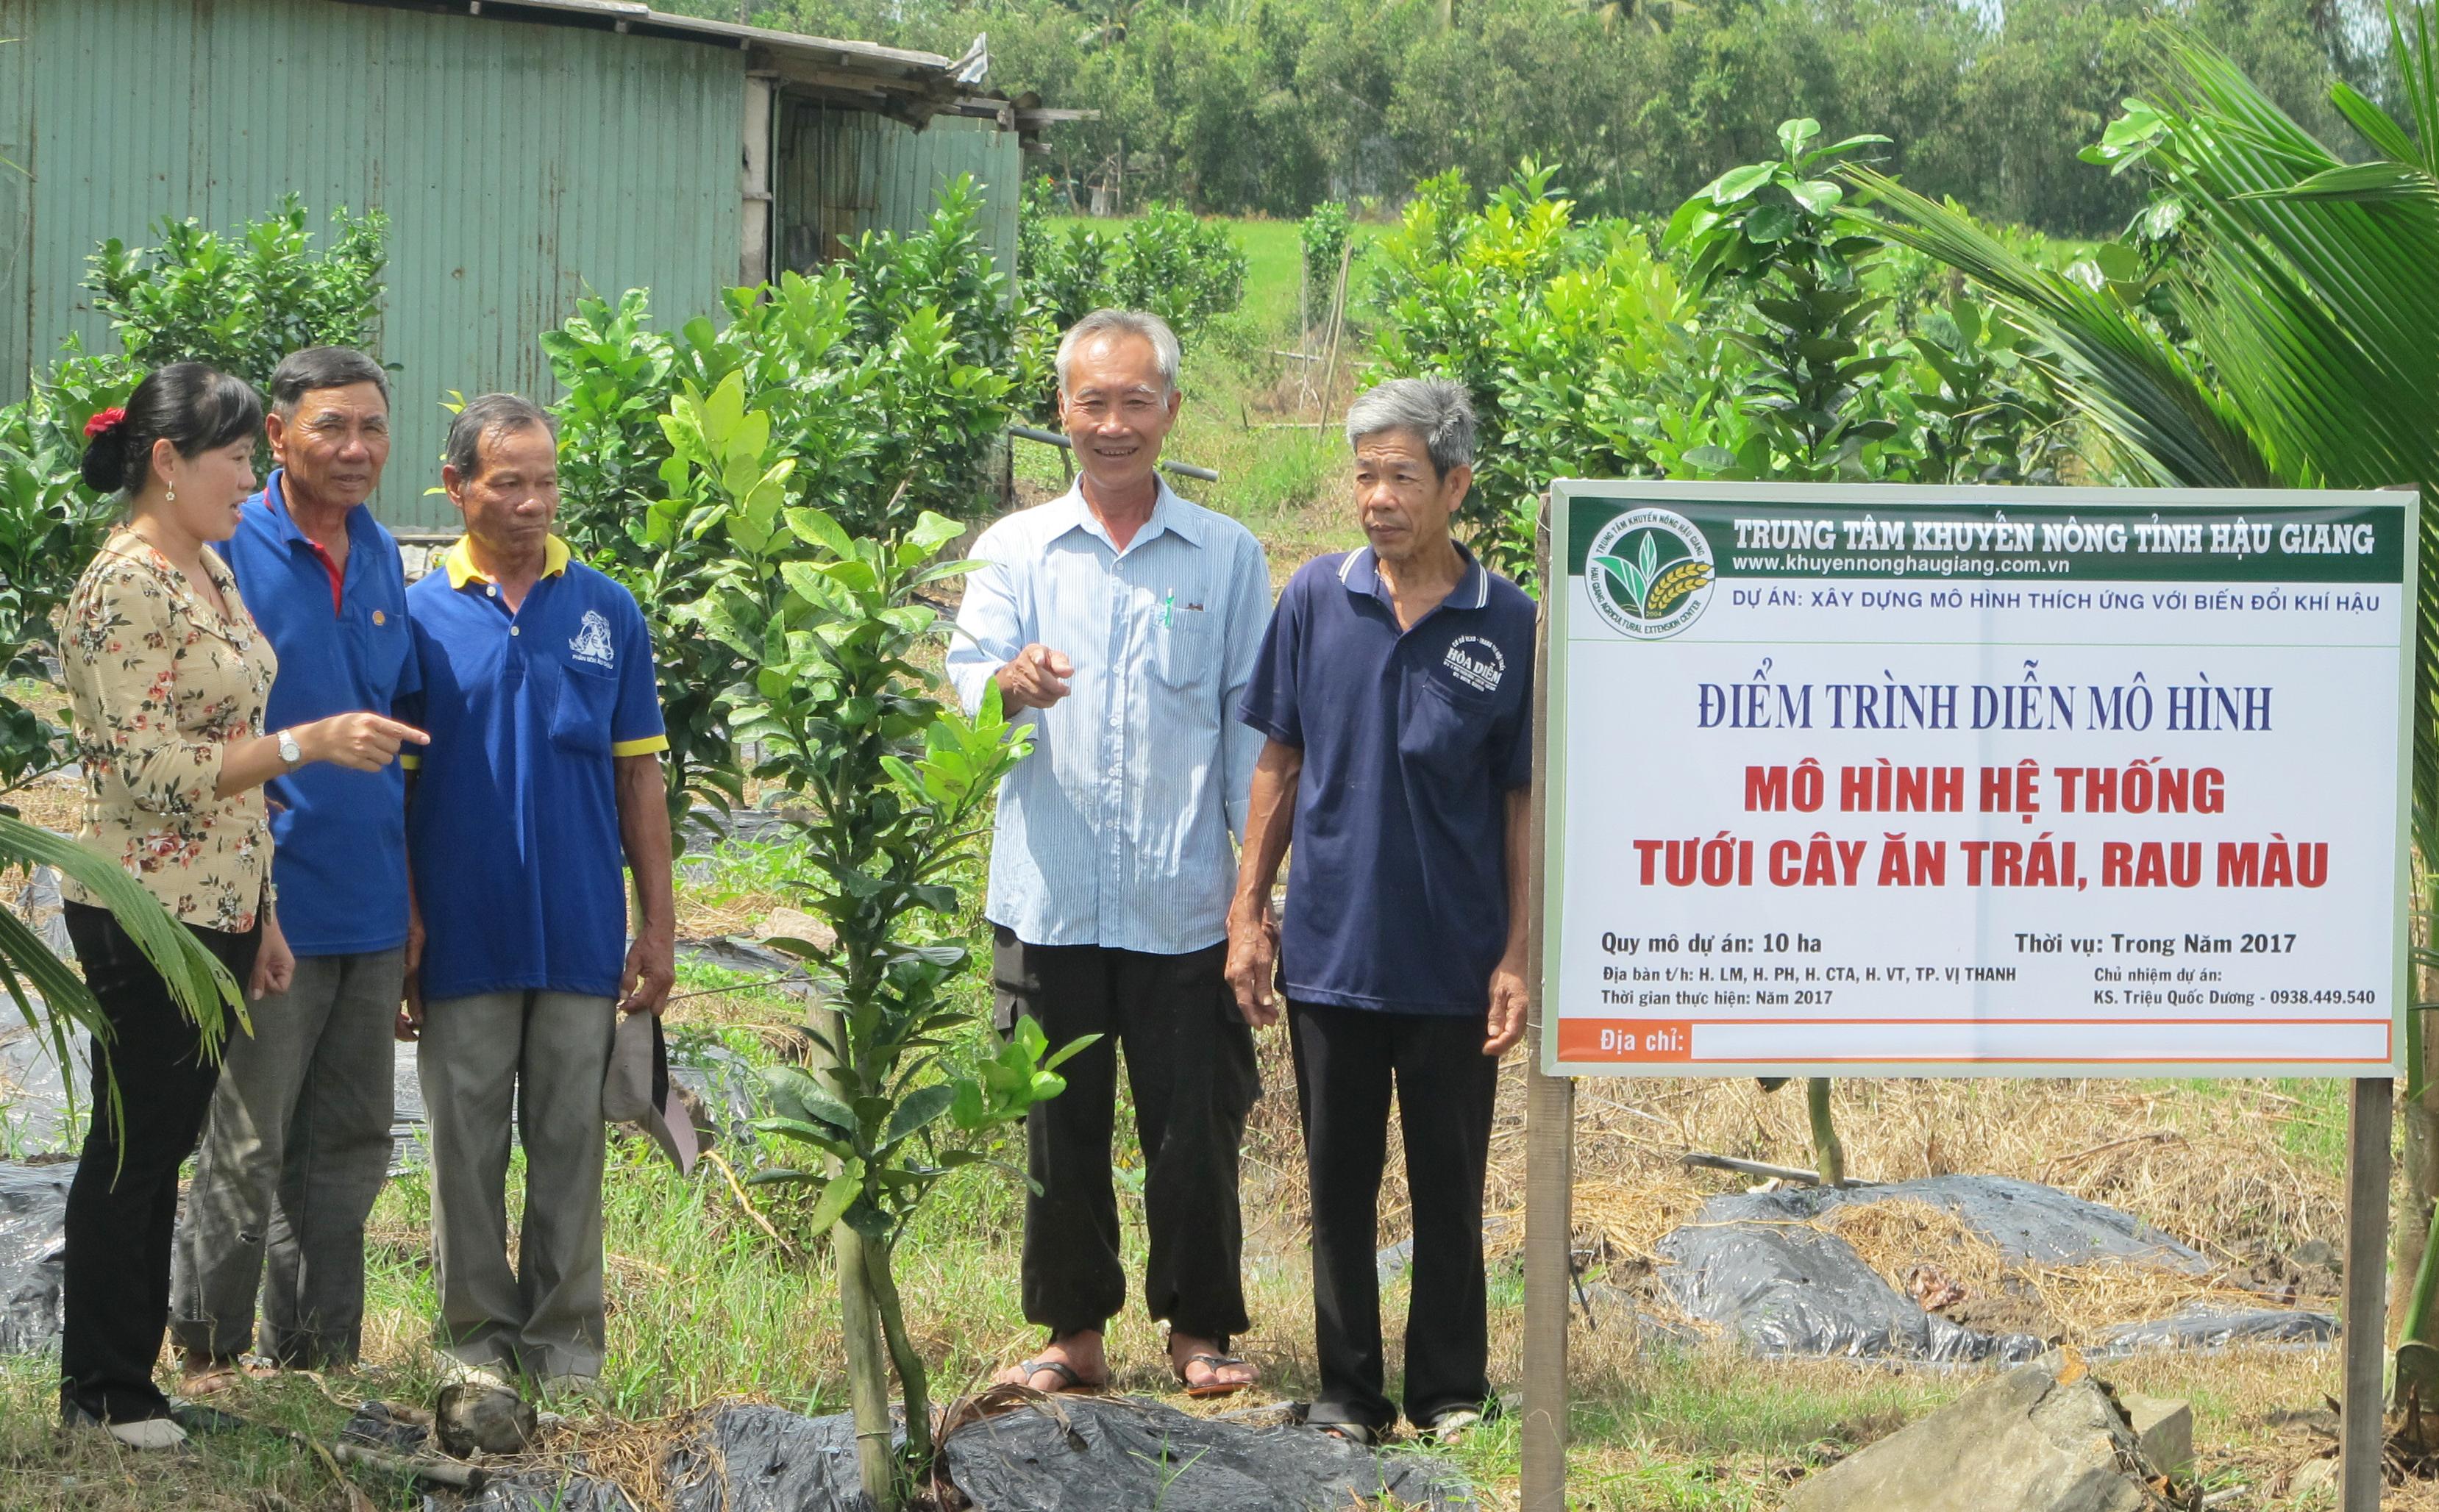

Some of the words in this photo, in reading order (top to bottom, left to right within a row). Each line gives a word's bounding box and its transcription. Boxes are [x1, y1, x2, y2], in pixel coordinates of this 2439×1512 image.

[1596, 532, 1614, 554] TRUNG
[1690, 535, 1705, 557] GIANG
[1733, 518, 1837, 550] TRUNG
[1842, 514, 1906, 552] TÂM
[1912, 510, 2035, 552] KHUYẾN
[2042, 516, 2128, 553] NÔNG
[2134, 513, 2204, 553] TỈNH
[2210, 517, 2273, 560] HẬU
[2279, 524, 2375, 554] GIANG
[1732, 554, 2070, 577] www.khuyennonghaugiang.com.vn
[1591, 583, 1604, 604] GIANG
[1600, 602, 1642, 634] AGRICULTURAL
[1645, 618, 1681, 634] EXTENSION
[1680, 600, 1702, 622] CENTER
[1733, 588, 1762, 609] DỰ
[1767, 586, 1803, 607] ÁN:
[1812, 587, 1854, 607] XÂY
[1862, 589, 1923, 610] DỰNG
[1931, 588, 1963, 608] MÔ
[1970, 588, 2021, 609] HÌNH
[2028, 588, 2092, 609] THÍCH
[2099, 589, 2146, 610] ỨNG
[2153, 590, 2187, 610] VỚI
[2194, 588, 2243, 610] BIẾN
[2251, 588, 2287, 611] ĐỔI
[2294, 591, 2329, 611] KHÍ
[2336, 591, 2380, 615] HẬU
[1446, 646, 1473, 670] HÒA
[1698, 657, 1814, 729] ĐIỂM
[1826, 669, 1959, 730] TRÌNH
[1970, 660, 2076, 730] DIỄN
[2087, 671, 2153, 731] MÔ
[2166, 671, 2273, 731] HÌNH
[1744, 757, 1824, 813] MÔ
[1840, 757, 1965, 813] HÌNH
[1979, 758, 2040, 824] HỆ
[2054, 756, 2225, 814] THỐNG
[1633, 830, 1753, 887] TƯỚI
[1768, 831, 1867, 887] CÂY
[1877, 832, 1946, 886] ĂN
[1959, 831, 2087, 891] TRÁI,
[2101, 841, 2202, 888] RAU
[2216, 832, 2329, 888] MÀU
[1601, 932, 1640, 956] Quy
[1648, 933, 1679, 953] mô
[1688, 932, 1715, 957] dự
[1721, 933, 1753, 953] án:
[1763, 932, 1790, 953] 10
[1798, 933, 1821, 953] ha
[2014, 933, 2062, 953] Thời
[2071, 938, 2103, 958] vụ:
[2111, 933, 2176, 957] Trong
[2185, 933, 2232, 953] Năm
[2240, 933, 2297, 953] 2017
[1603, 966, 1627, 984] Địa
[1633, 966, 1660, 981] bàn
[1665, 967, 1693, 981] t/h:
[1699, 967, 1714, 981] H.
[1720, 967, 1748, 984] LM,
[1753, 967, 1768, 981] H.
[1774, 967, 1799, 984] PH,
[1805, 967, 1820, 981] H.
[1826, 967, 1859, 984] CTA,
[1865, 967, 1881, 981] H.
[1887, 967, 1910, 984] VT,
[1916, 967, 1939, 981] TP.
[1945, 967, 1959, 985] VỊ
[1965, 967, 2016, 982] THANH
[2094, 966, 2122, 982] Chủ
[2128, 968, 2172, 984] nhiệm
[2176, 968, 2196, 984] dự
[2199, 968, 2221, 982] án:
[1601, 989, 1634, 1005] Thời
[1639, 991, 1670, 1007] gian
[1676, 991, 1709, 1007] thực
[1715, 991, 1750, 1008] hiện:
[1756, 991, 1789, 1005] Năm
[1794, 990, 1833, 1005] 2017
[2094, 990, 2118, 1005] KS.
[2123, 990, 2162, 1007] Triệu
[2167, 989, 2204, 1007] Quốc
[2210, 990, 2255, 1007] Dương
[2270, 990, 2376, 1005] 0938.449.540
[1600, 1029, 1636, 1055] Địa
[1645, 1027, 1684, 1052] chỉ:
